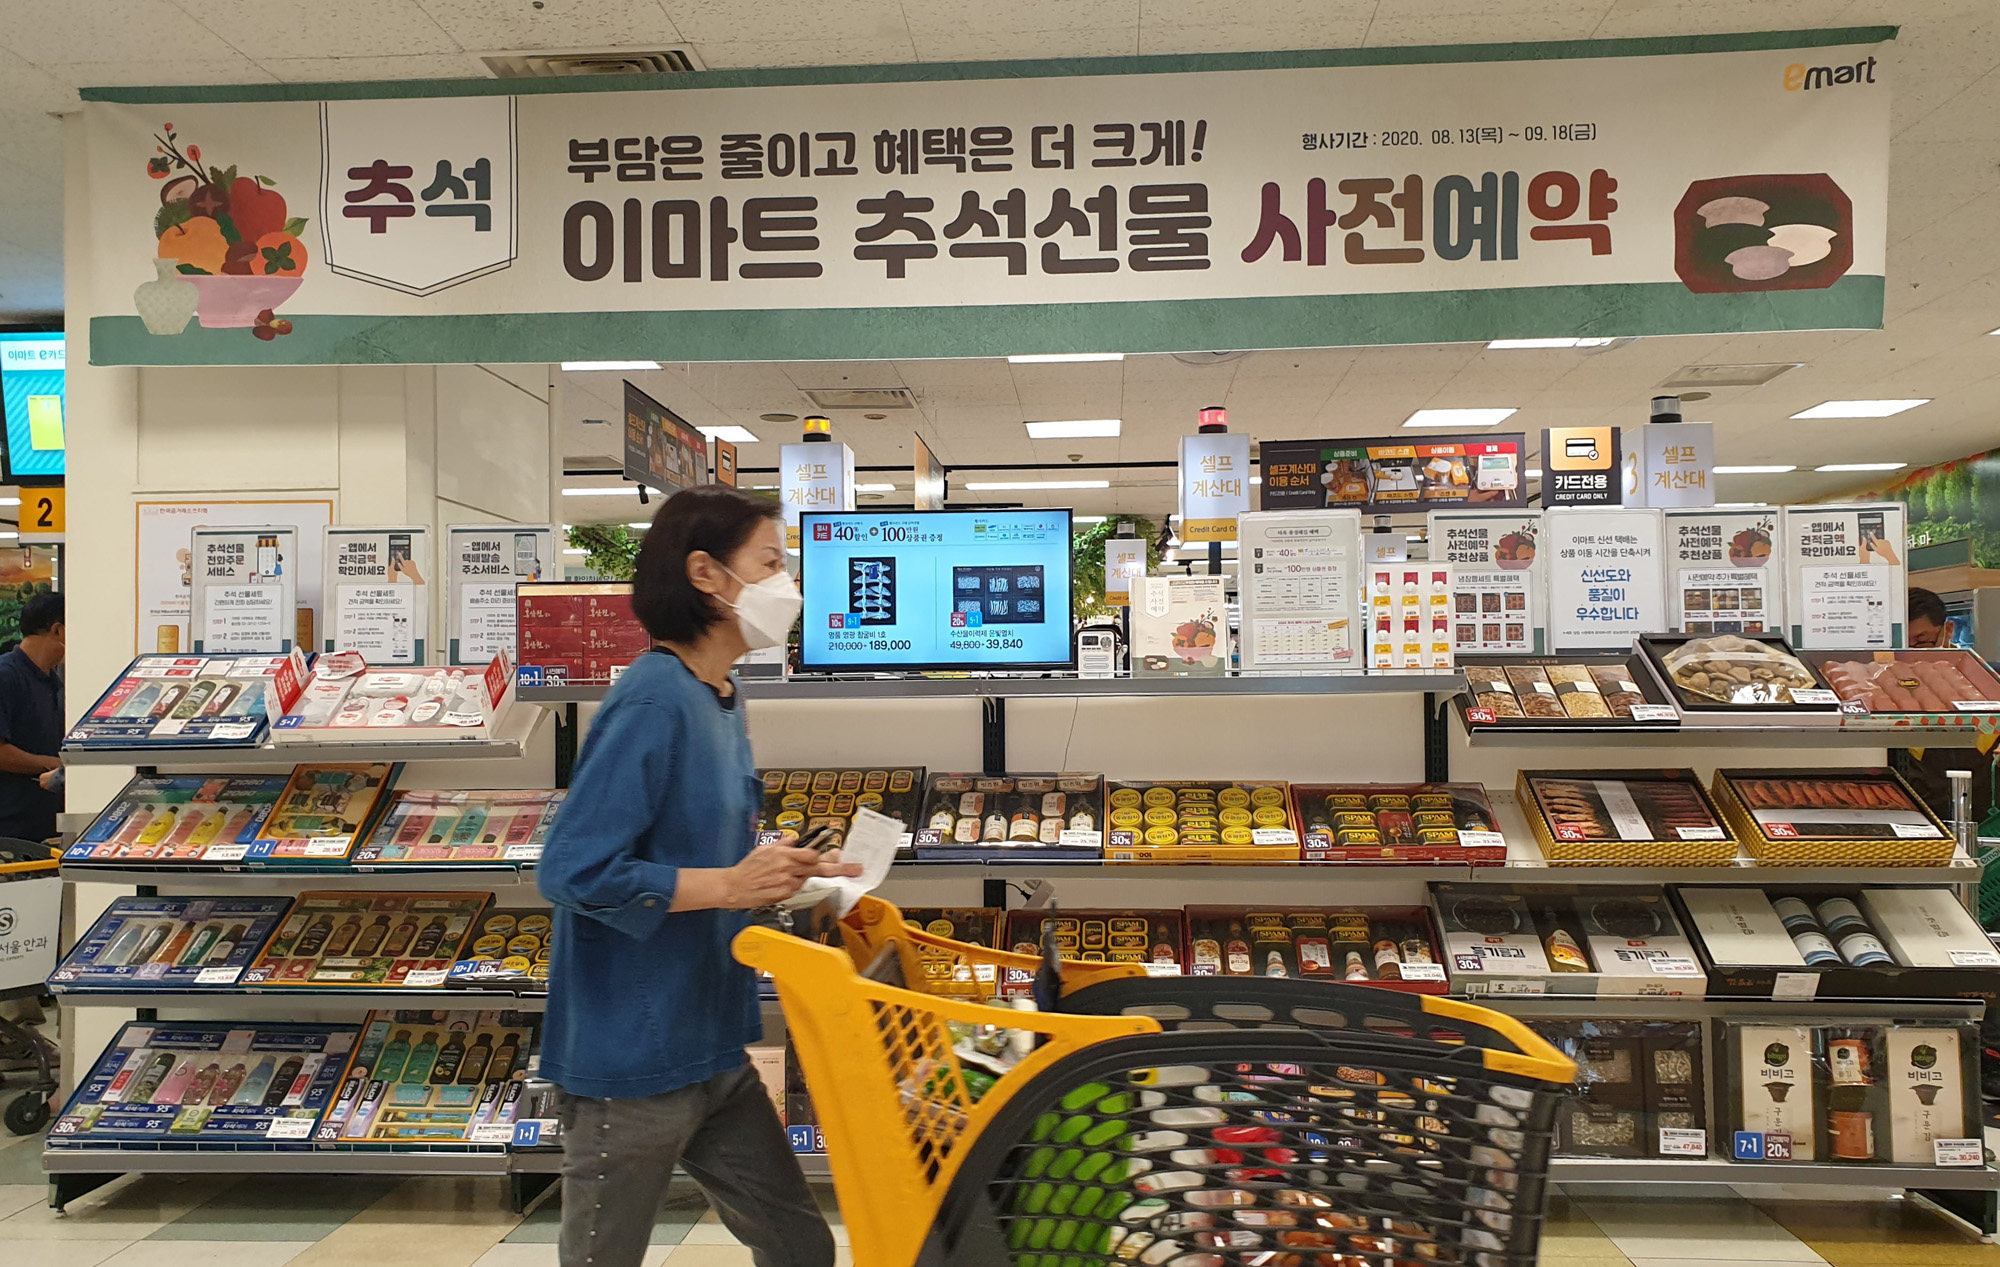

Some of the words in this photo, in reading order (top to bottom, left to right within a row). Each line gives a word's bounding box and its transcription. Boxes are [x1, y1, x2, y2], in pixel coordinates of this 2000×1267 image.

[1782, 56, 1877, 91] emart
[1302, 131, 1369, 151] 행사기간
[1381, 130, 1424, 148] 2020.
[567, 135, 704, 183] 부담은
[720, 131, 859, 180] 줄이고
[873, 126, 1014, 175] 혜택은
[1031, 123, 1075, 170] 더
[1092, 119, 1207, 167] 크게!
[342, 157, 492, 234] 추석
[563, 195, 825, 284] 이마트
[853, 183, 1213, 280] 추석선물
[1240, 168, 1619, 267] 사전예약
[8, 349, 37, 362] 이마트
[1662, 446, 1697, 465] 셀프
[1200, 455, 1233, 474] 셀프
[1269, 464, 1317, 475] 셀프계산대
[796, 463, 828, 482] 셀프
[1269, 476, 1289, 487] 이용
[1290, 475, 1310, 486] 순서
[1555, 475, 1608, 490] 카드전용
[1655, 470, 1706, 490] 계산대
[1192, 478, 1242, 498] 계산대
[789, 487, 836, 505] 계산대
[1555, 493, 1575, 501] CREDIT
[1576, 492, 1592, 500] CARD
[1593, 492, 1608, 500] ONLY
[37, 497, 53, 527] 2
[1189, 525, 1210, 534] Credit
[1211, 524, 1229, 533] Card
[1679, 525, 1722, 537] 추석선물
[1811, 521, 1845, 533] 앱에서
[881, 526, 906, 542] 100
[1447, 528, 1489, 540] 추석선물
[1447, 540, 1489, 551] 사전예약
[1572, 536, 1597, 545] 이마트
[1597, 535, 1613, 545] 신선
[1614, 535, 1639, 545] 택배는
[1679, 537, 1722, 549] 사전예약
[1801, 534, 1845, 546] 견적금액
[207, 543, 245, 554] 추석선물
[348, 543, 377, 553] 앱에서
[472, 542, 501, 552] 앱에서
[1375, 546, 1397, 559] 셀프
[1801, 546, 1857, 557] 확인하세요
[462, 554, 501, 564] 택배발송
[1116, 552, 1137, 564] 셀프
[1447, 552, 1489, 563] 추천상품
[1560, 549, 1577, 559] 상품
[1577, 548, 1593, 558] 이동
[1595, 548, 1619, 558] 시간을
[1620, 548, 1652, 558] 단축시켜
[1679, 549, 1722, 560] 추천상품
[207, 555, 245, 566] 전화주문
[338, 554, 377, 565] 견적금액
[207, 567, 235, 577] 서비스
[338, 566, 386, 576] 확인하세요
[462, 565, 510, 575] 주소서비스
[1580, 569, 1632, 583] 신선도와
[1588, 588, 1626, 602] 품질이
[1576, 607, 1640, 621] 우수합니다
[828, 641, 863, 651] 210,000
[869, 640, 912, 651] 189,000
[950, 640, 981, 650] 49,800
[986, 638, 1024, 649] 39,840
[1844, 705, 1867, 714] 40%
[1470, 711, 1492, 721] 30%
[279, 718, 297, 728] 5+1
[1334, 796, 1361, 805] SPAM
[1379, 796, 1406, 804] SPAM
[109, 800, 131, 822] 2080
[1344, 814, 1371, 822] SPAM
[1422, 813, 1450, 821] SPAM
[1348, 832, 1376, 840] SPAM
[1426, 831, 1454, 839] SPAM
[1559, 829, 1582, 840] 30%
[1770, 827, 1795, 837] 30%
[919, 834, 939, 844] 30%
[1110, 836, 1132, 846] 30%
[1307, 839, 1329, 848] 30%
[70, 846, 90, 857] 10+1
[252, 842, 271, 854] 1+1
[356, 851, 376, 860] 20%
[1117, 920, 1141, 928] SPAM
[1259, 930, 1286, 938] SPAM
[1339, 930, 1365, 938] SPAM
[24, 936, 49, 953] 안과
[453, 963, 473, 974] 10+1
[1458, 959, 1481, 970] 30%
[54, 971, 75, 981] 30%
[245, 972, 264, 982] 30%
[1009, 970, 1029, 980] 30%
[1761, 1069, 1795, 1080] 비비고
[1908, 1071, 1943, 1082] 비비고
[55, 1122, 76, 1134] 30%
[317, 1127, 338, 1139] 30%
[519, 1126, 535, 1141] 1+1
[792, 1130, 808, 1147] 5+1
[1682, 1143, 1703, 1151] 47,840
[1740, 1138, 1758, 1154] 7+1
[1767, 1144, 1790, 1158] 20%
[1958, 1153, 1980, 1161] 30,240
